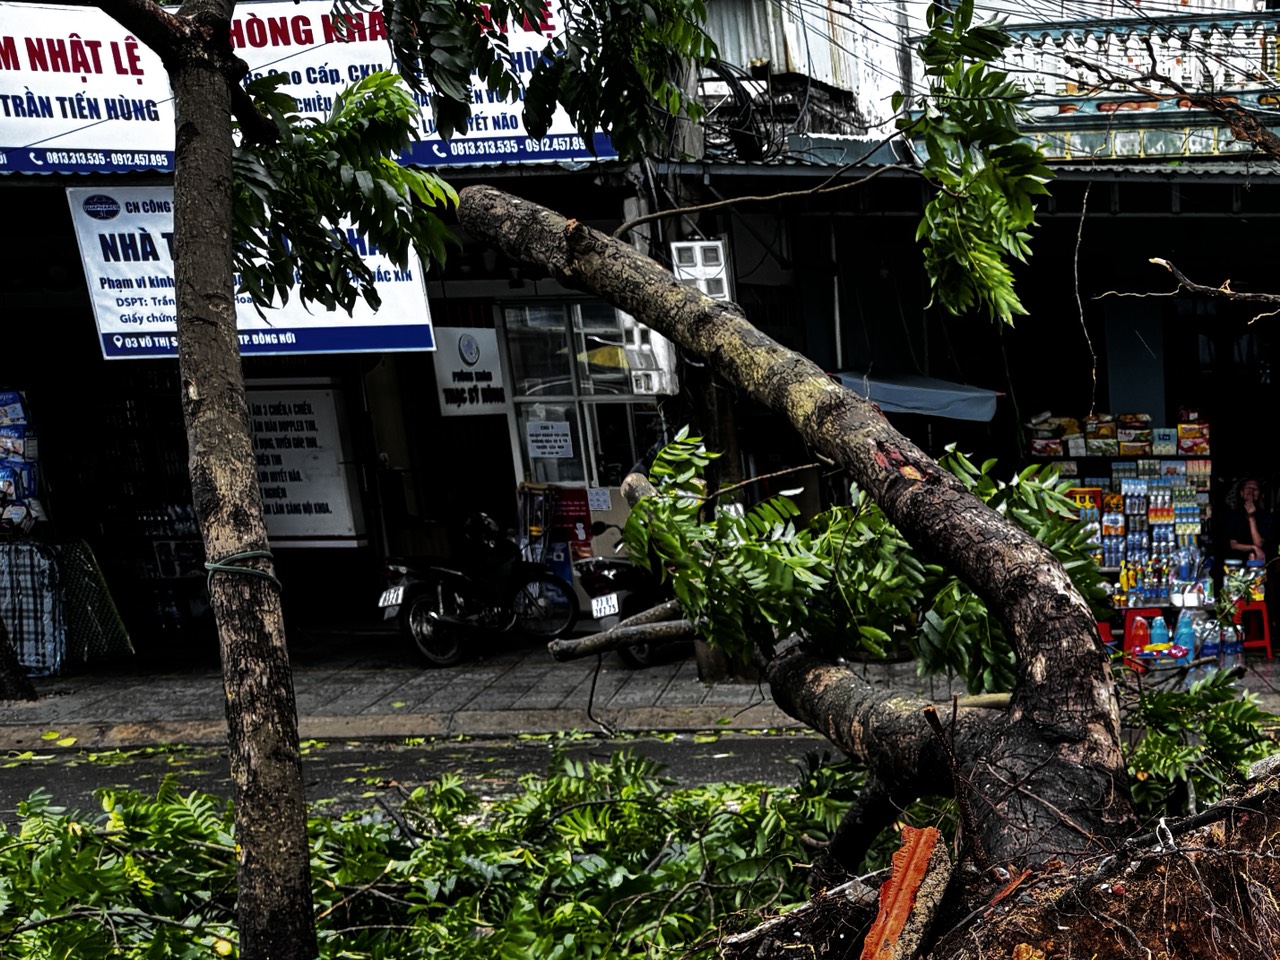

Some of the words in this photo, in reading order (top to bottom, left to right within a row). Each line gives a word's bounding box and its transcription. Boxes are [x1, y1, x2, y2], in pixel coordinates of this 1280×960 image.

[24, 33, 103, 83] NHẬT
[110, 35, 145, 85] LỆ
[306, 62, 345, 85] Cấp,
[0, 86, 54, 118] TRẦN
[55, 91, 101, 119] TIẾN
[104, 94, 160, 121] HÙNG
[492, 112, 518, 131] NÃO
[450, 138, 518, 156] 0813.313.535
[46, 152, 104, 165] 0813.313.535
[111, 153, 168, 166] 0912.457.895
[125, 201, 142, 213] CN
[143, 199, 171, 213] CÔNG
[99, 227, 160, 262] NHÀ
[99, 277, 134, 293] Phạm
[135, 276, 147, 289] vi
[393, 269, 413, 283] XIN
[116, 297, 148, 307] DSPT:
[120, 314, 144, 326] Giấy
[124, 337, 138, 348] 03
[138, 335, 152, 348] VÕ
[153, 336, 170, 350] THỊ
[238, 335, 252, 345] TP.
[252, 331, 278, 345] ĐỒNG
